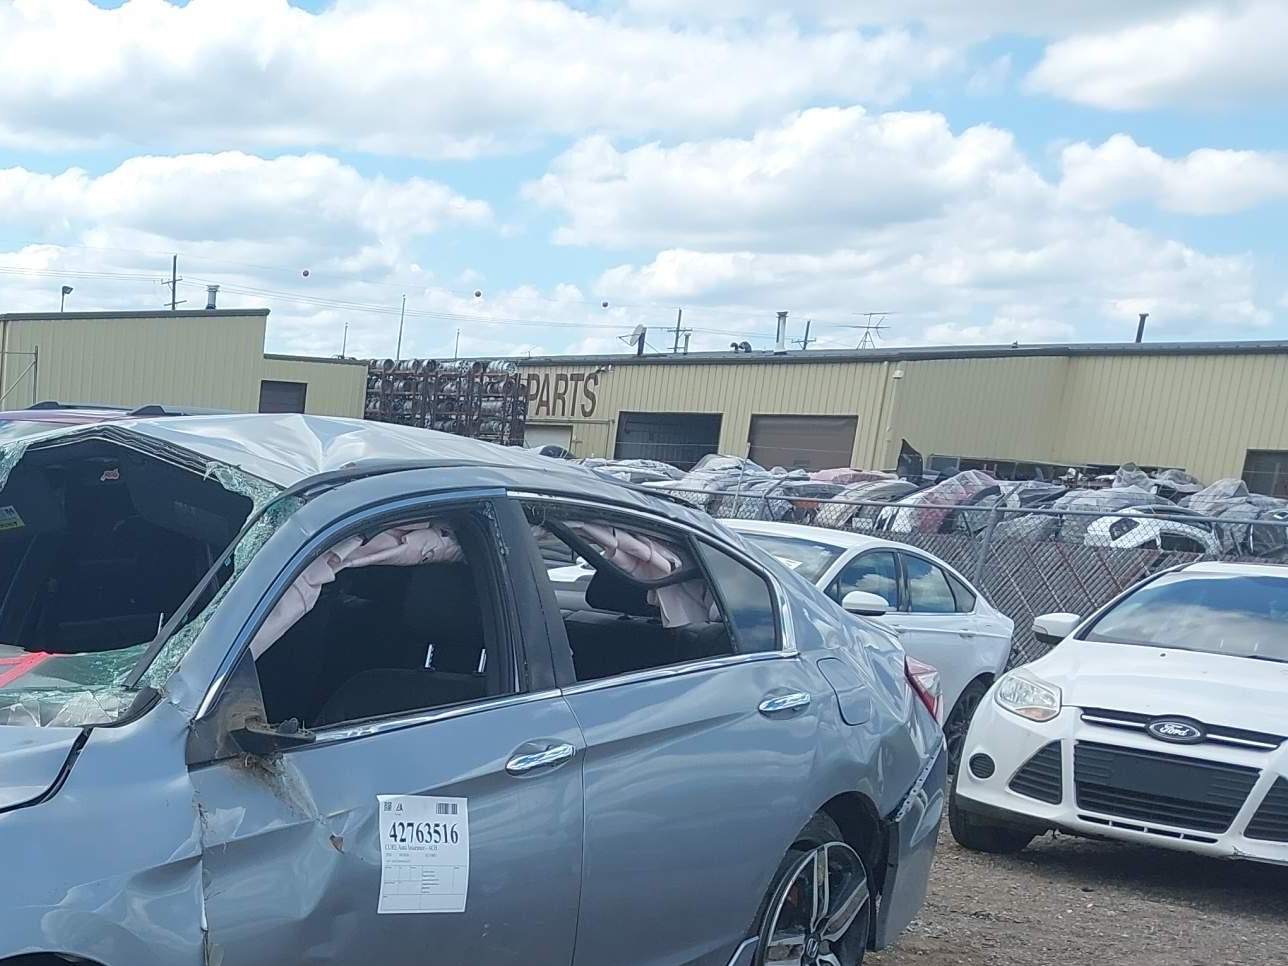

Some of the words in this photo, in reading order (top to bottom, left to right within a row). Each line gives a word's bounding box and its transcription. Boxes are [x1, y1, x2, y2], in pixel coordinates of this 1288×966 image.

[527, 372, 599, 418] PARTS
[1159, 722, 1188, 737] Ford
[389, 821, 459, 844] 42763516
